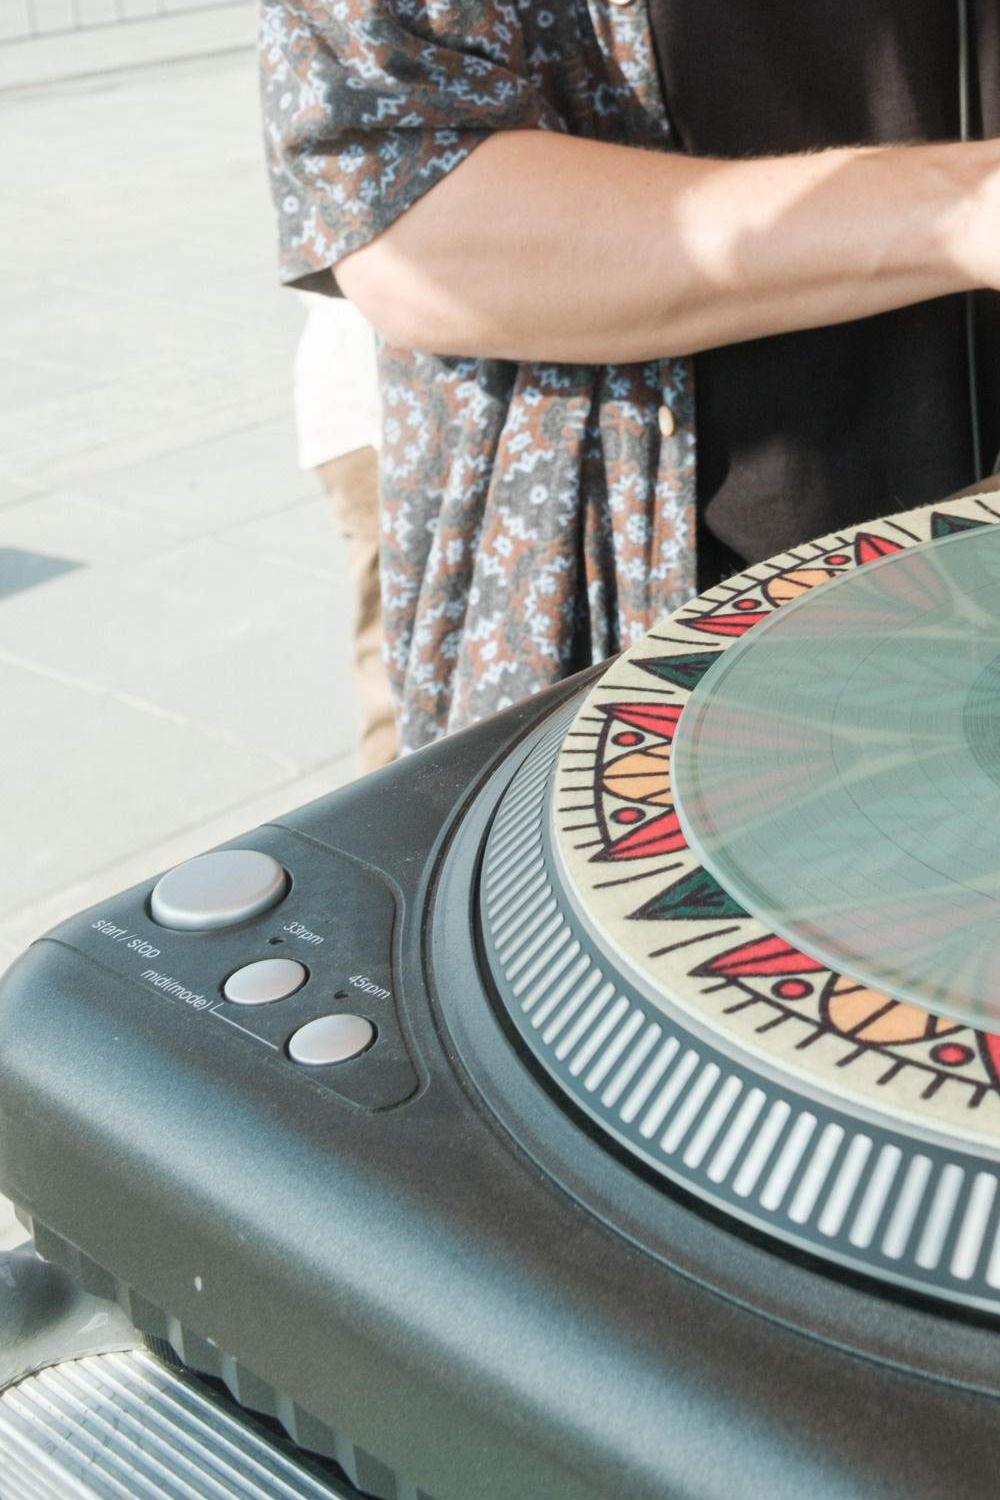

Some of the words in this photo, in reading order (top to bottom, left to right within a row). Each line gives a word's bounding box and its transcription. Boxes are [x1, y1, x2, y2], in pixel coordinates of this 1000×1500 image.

[91, 919, 128, 940] start
[127, 938, 161, 959] stop
[282, 921, 325, 946] 33rpm
[140, 969, 214, 1011] midi(mode)
[348, 974, 391, 1000] 45rpm
